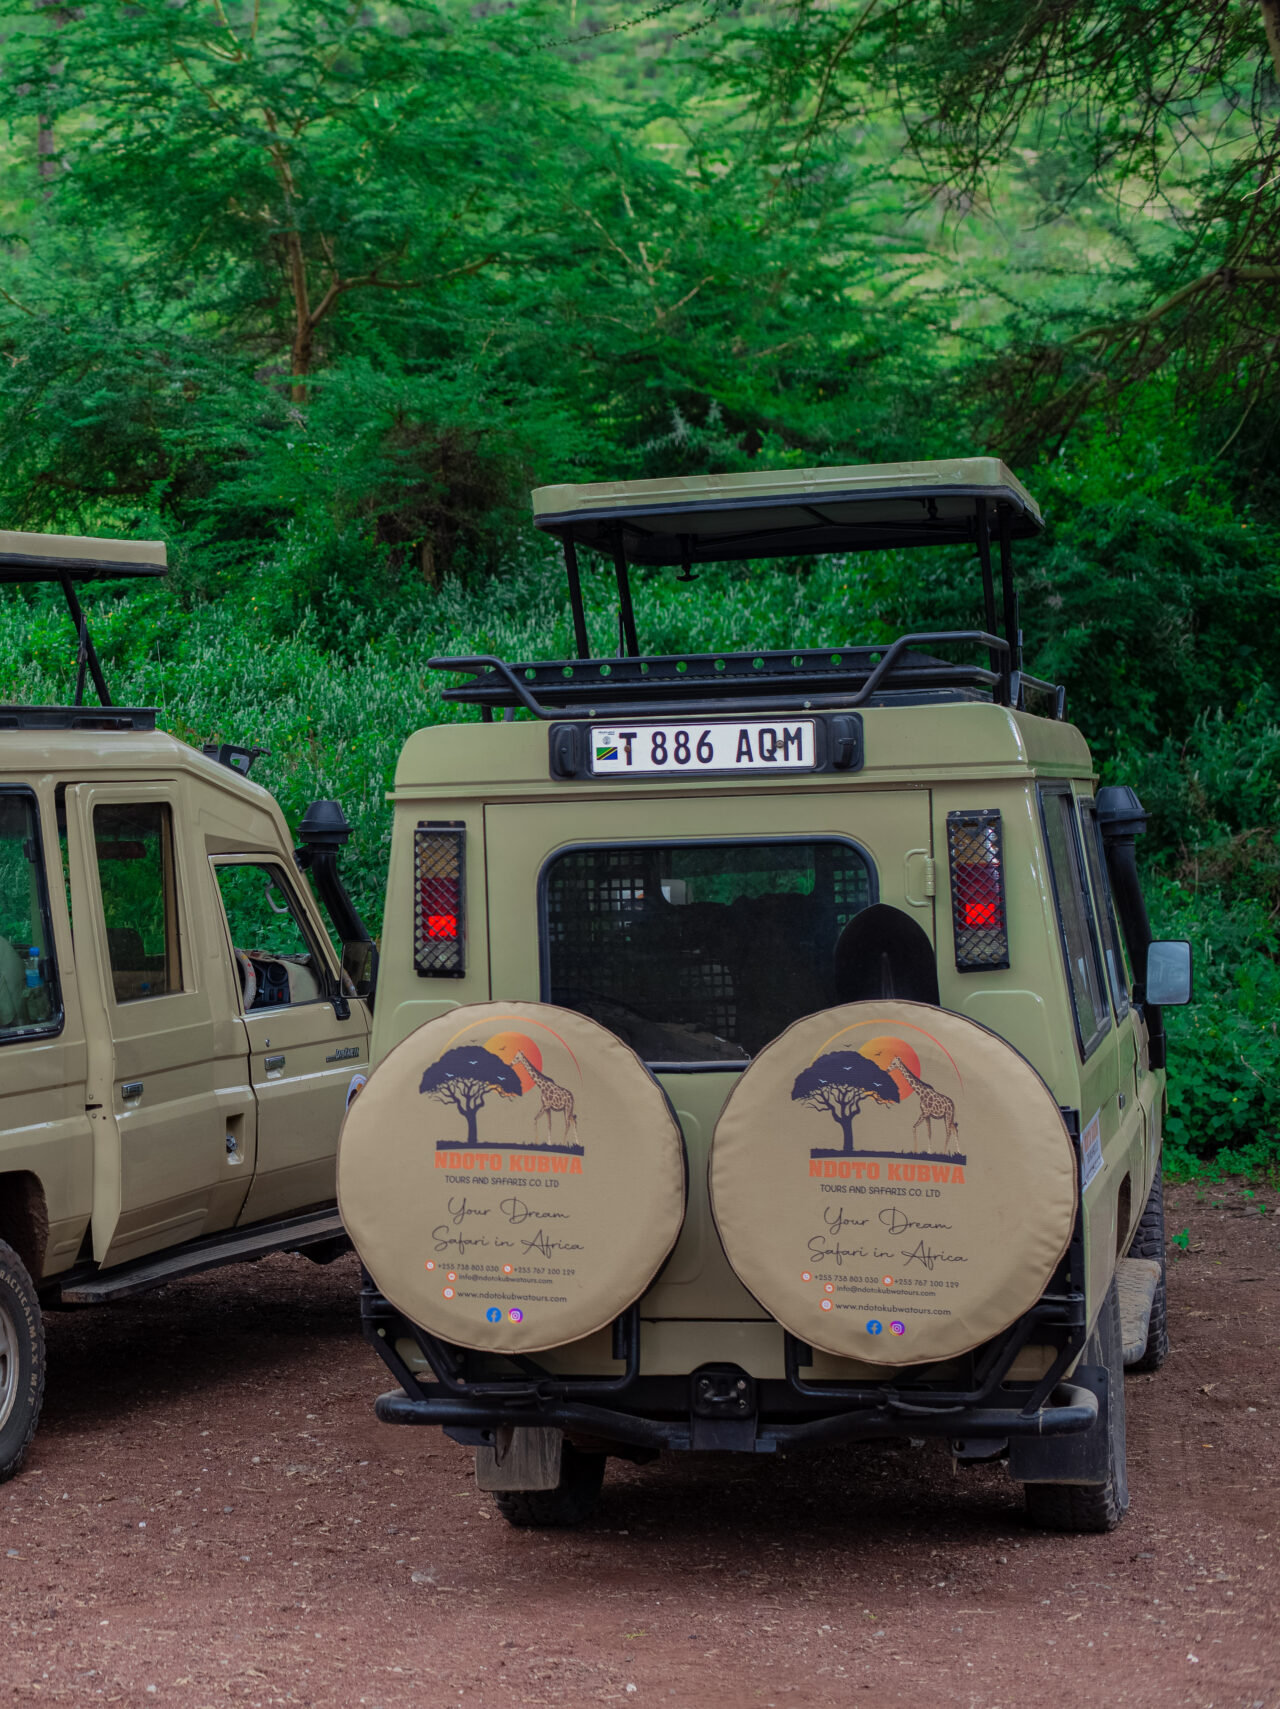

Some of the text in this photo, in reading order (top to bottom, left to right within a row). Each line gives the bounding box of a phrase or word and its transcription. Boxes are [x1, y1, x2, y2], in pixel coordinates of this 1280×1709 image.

[619, 726, 803, 766] T 886 AQM
[435, 1152, 583, 1174] NDOTO KUBWA
[809, 1160, 965, 1184] NDOTO KUBWA
[445, 1175, 470, 1184] TOURS
[472, 1176, 488, 1185] AND
[491, 1178, 526, 1187] SAFARIS
[545, 1179, 559, 1188] LTD
[820, 1184, 847, 1193] TOURS
[849, 1185, 866, 1194] AND
[870, 1186, 906, 1196] SAFARIS
[926, 1189, 940, 1198] LTD
[448, 1197, 569, 1224] Your Dream
[824, 1206, 952, 1235] Your Dream
[432, 1225, 584, 1259] Safari in Africa
[808, 1236, 968, 1271] Safari in Africa
[815, 1274, 832, 1282] +255
[894, 1278, 912, 1286] +255
[915, 1279, 927, 1287] 767
[457, 1291, 567, 1303] www.ndotokubwatours.com
[837, 1285, 936, 1297] info@ndotokubwatours.com
[835, 1303, 951, 1315] www.ndotokubwatours.com
